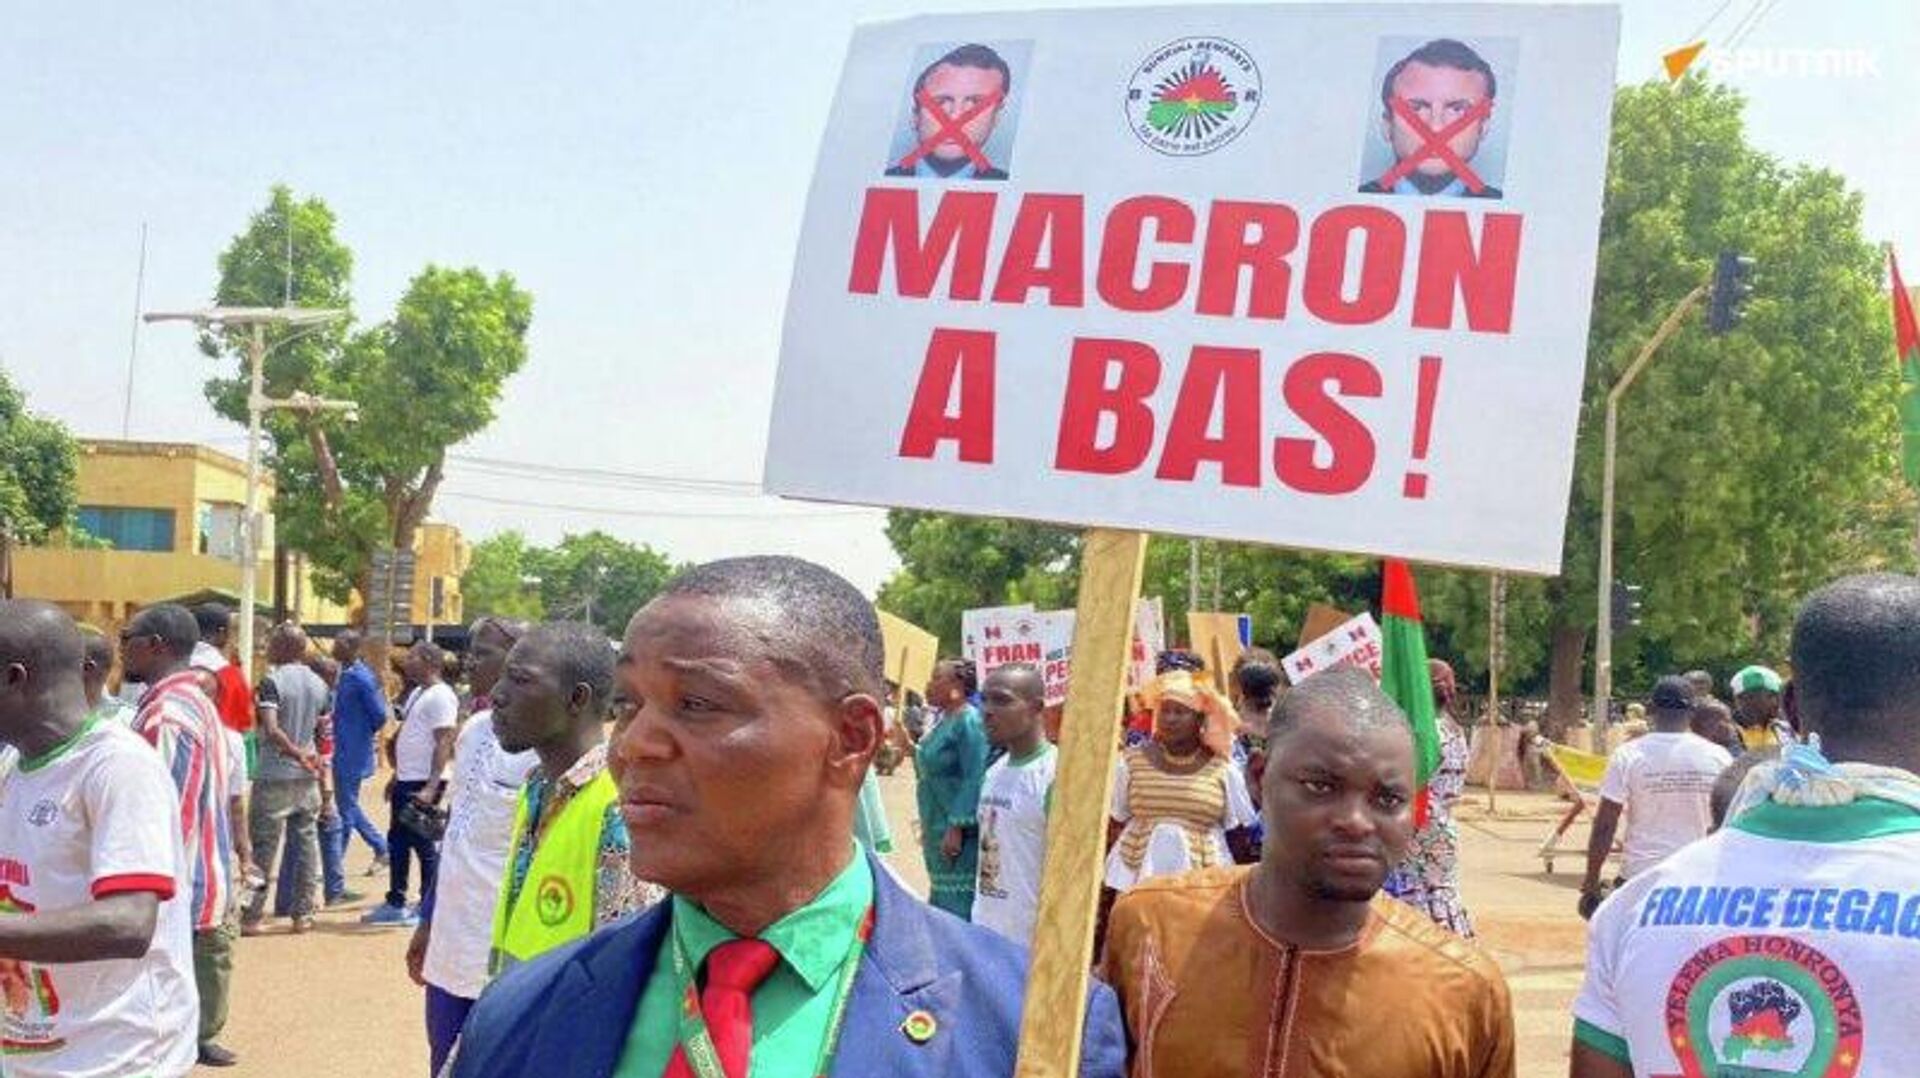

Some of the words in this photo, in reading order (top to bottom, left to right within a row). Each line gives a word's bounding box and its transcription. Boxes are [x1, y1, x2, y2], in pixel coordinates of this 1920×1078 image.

[848, 187, 1523, 334] MACRON
[899, 327, 997, 464] A
[984, 642, 1041, 664] FRAN
[1638, 886, 1779, 928] FRANCE
[1666, 941, 1733, 1030] YELEMA
[1744, 936, 1862, 1037] HONRONYA
